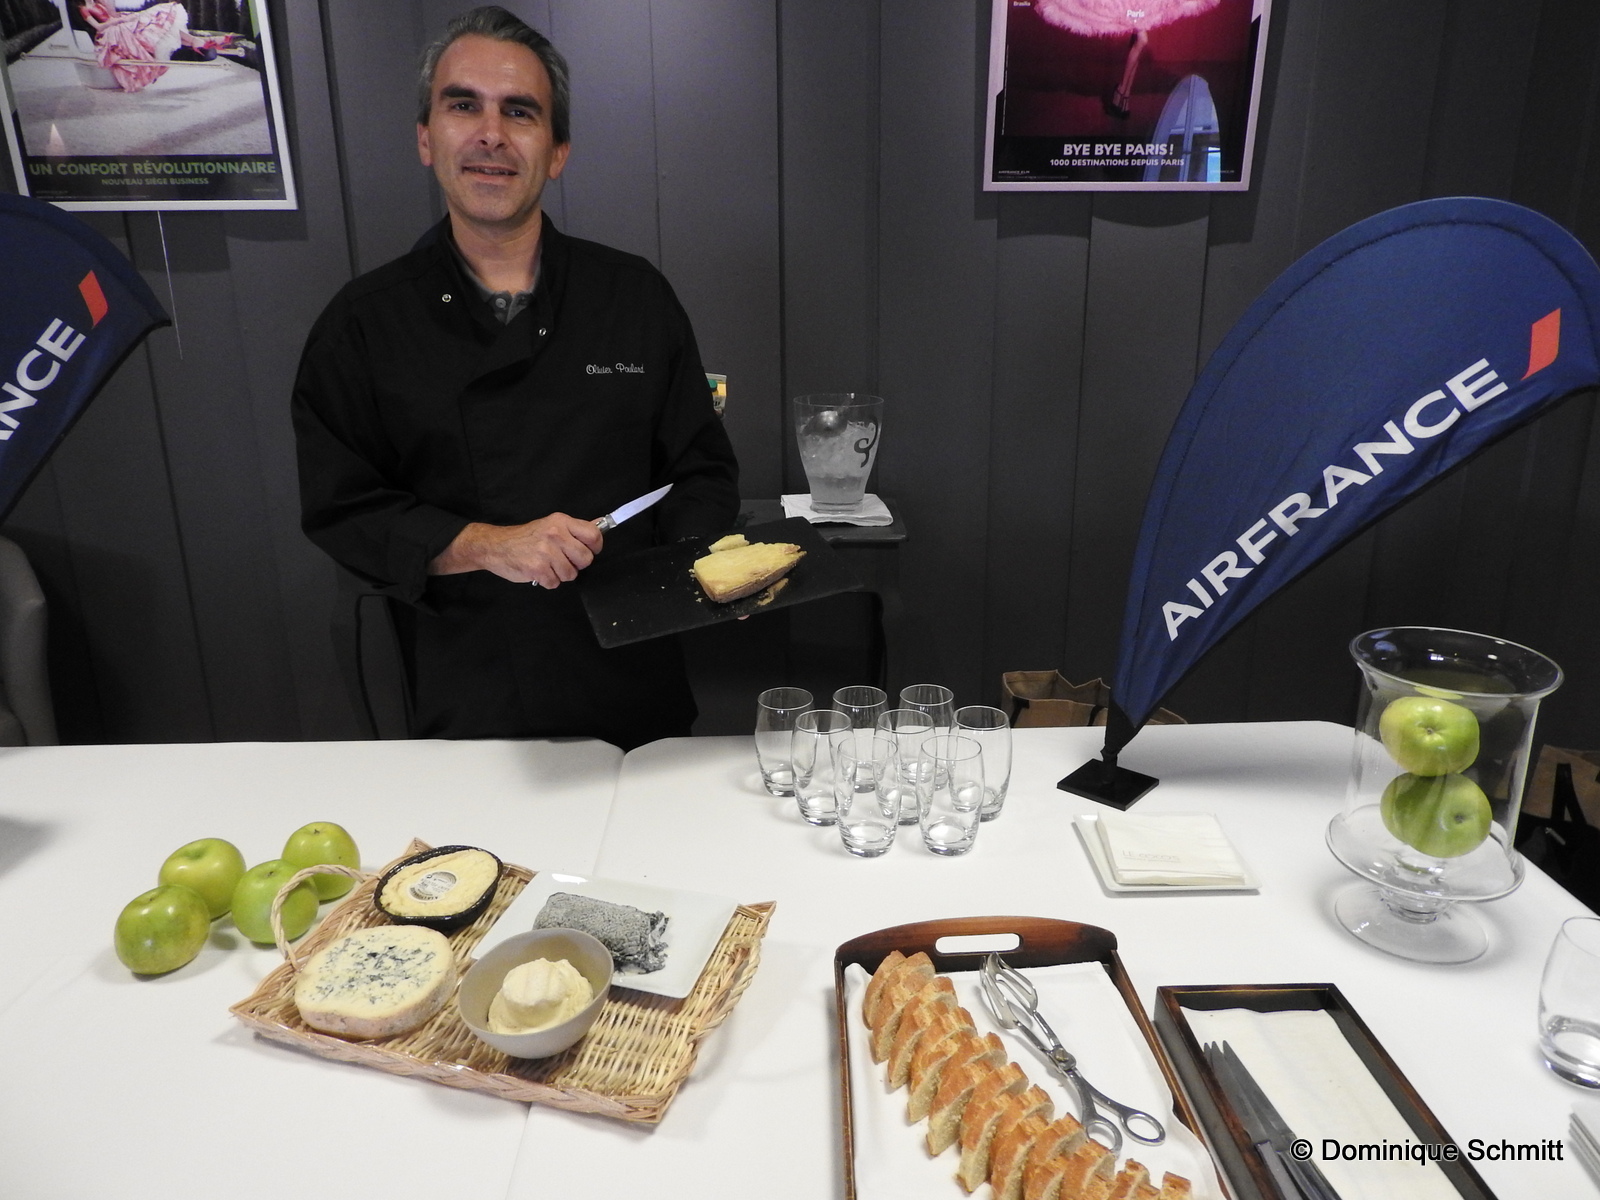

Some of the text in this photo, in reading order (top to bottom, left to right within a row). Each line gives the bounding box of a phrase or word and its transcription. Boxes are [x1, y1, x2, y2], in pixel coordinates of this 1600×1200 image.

[1126, 8, 1145, 18] Paris
[1063, 143, 1091, 156] BYE
[1094, 143, 1121, 156] BYE
[29, 160, 276, 176] UN CONFORT RÉVOLUTIONNAIRE
[1050, 158, 1185, 167] 1000 DESTINATIONS DEPUIS PARIS
[101, 178, 143, 186] NOUVEAU
[170, 177, 209, 185] BUSINESS
[0, 317, 87, 441] NCE
[1161, 357, 1509, 642] AIRFRANCE
